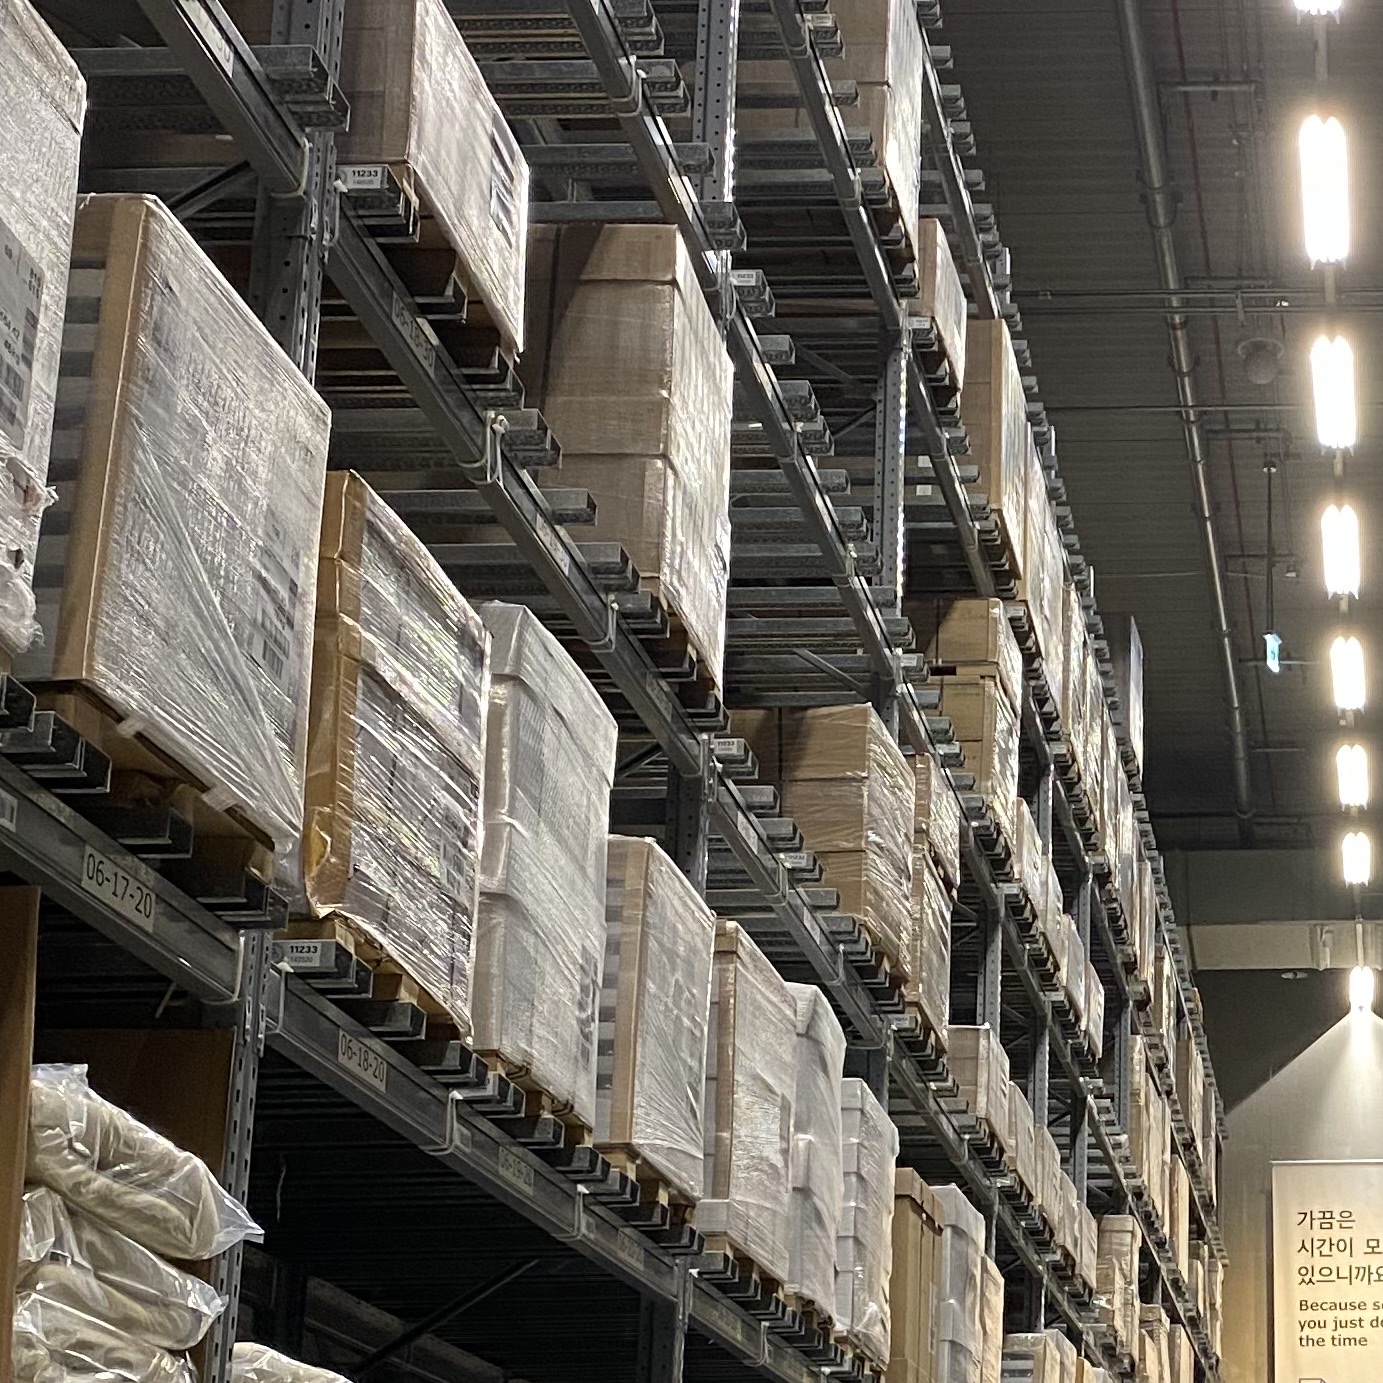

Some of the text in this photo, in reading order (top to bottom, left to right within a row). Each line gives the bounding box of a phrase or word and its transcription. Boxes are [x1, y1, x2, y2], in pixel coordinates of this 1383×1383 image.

[86, 852, 154, 919] 06-17-20
[289, 944, 318, 954] 11233
[340, 1033, 386, 1084] 06-18-20
[1297, 1237, 1354, 1259] 시간이
[1298, 1298, 1367, 1312] Because
[1298, 1318, 1327, 1334] you
[1331, 1315, 1365, 1332] just
[1298, 1334, 1368, 1347] the time
